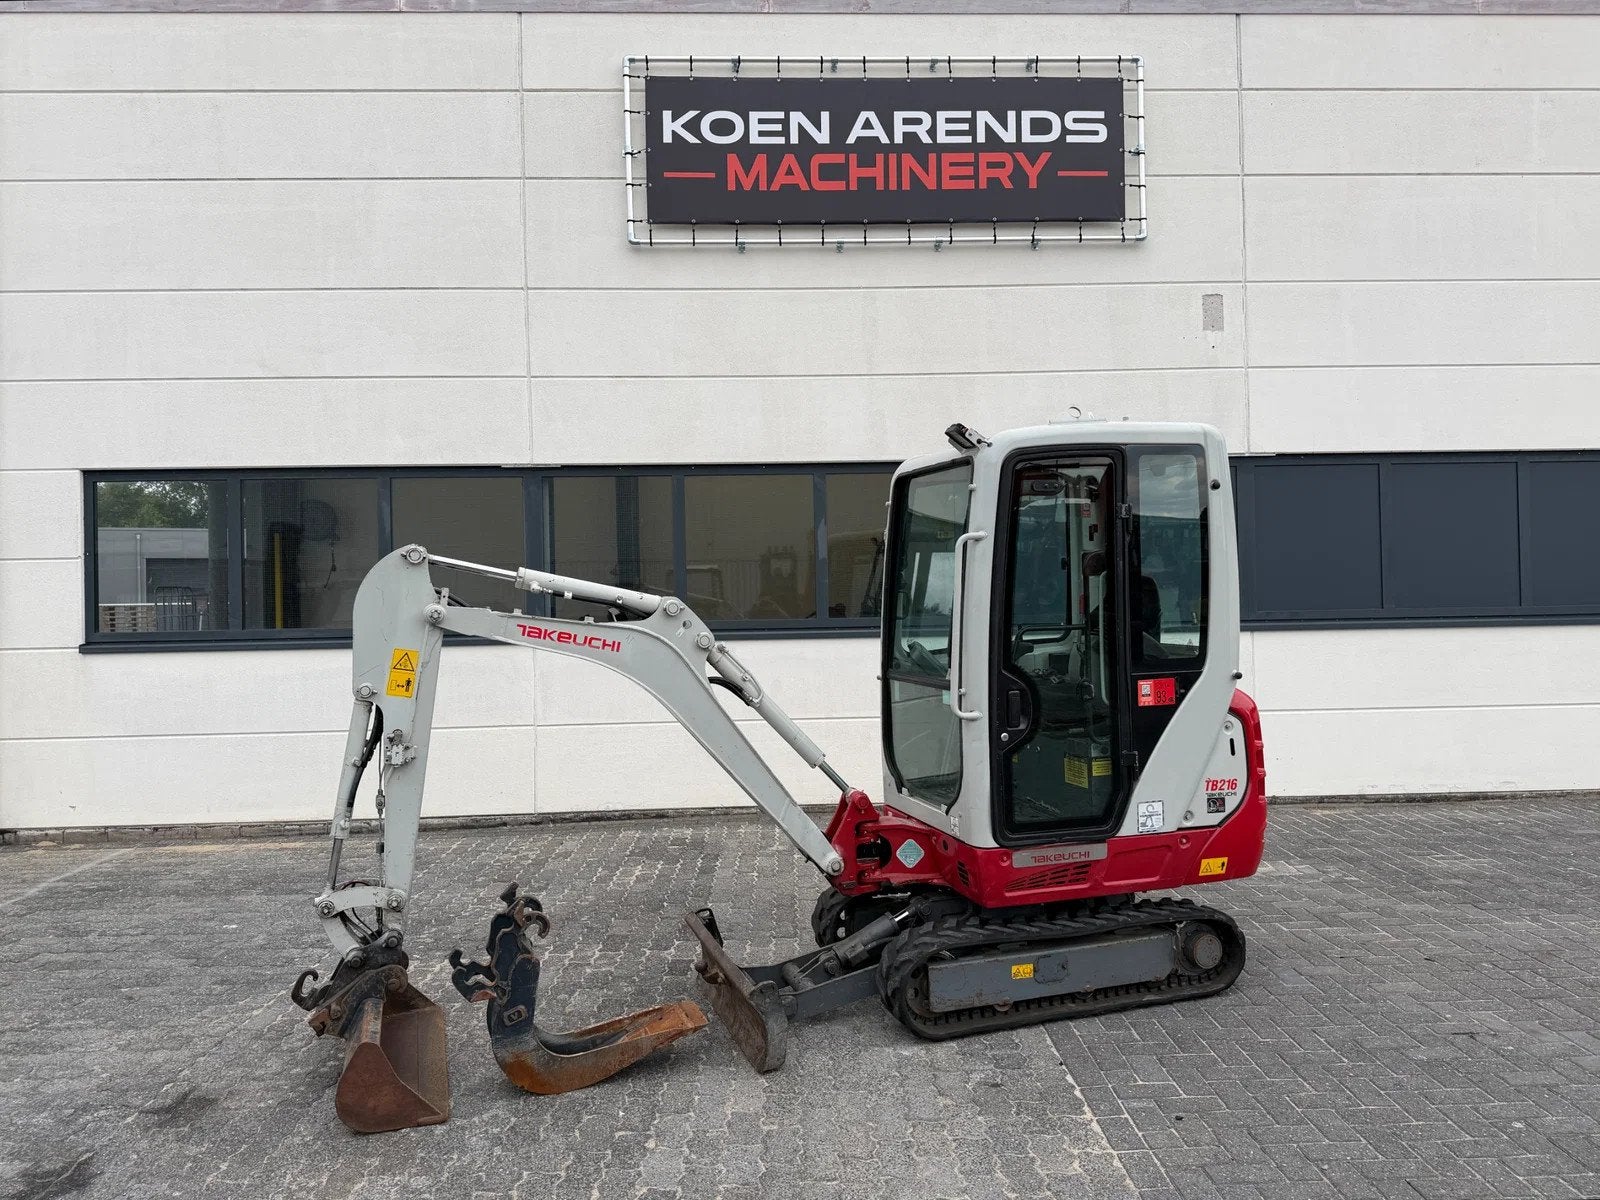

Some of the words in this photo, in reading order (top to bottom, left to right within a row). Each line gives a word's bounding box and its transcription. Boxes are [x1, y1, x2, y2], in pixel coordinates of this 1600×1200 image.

[662, 110, 830, 144] KOEN
[845, 110, 1108, 144] ARENDS
[726, 152, 1052, 191] MACHINERY
[516, 623, 622, 653] TAKEUCHI
[1205, 778, 1238, 791] TB216
[1030, 850, 1090, 864] TAKEUCHI
